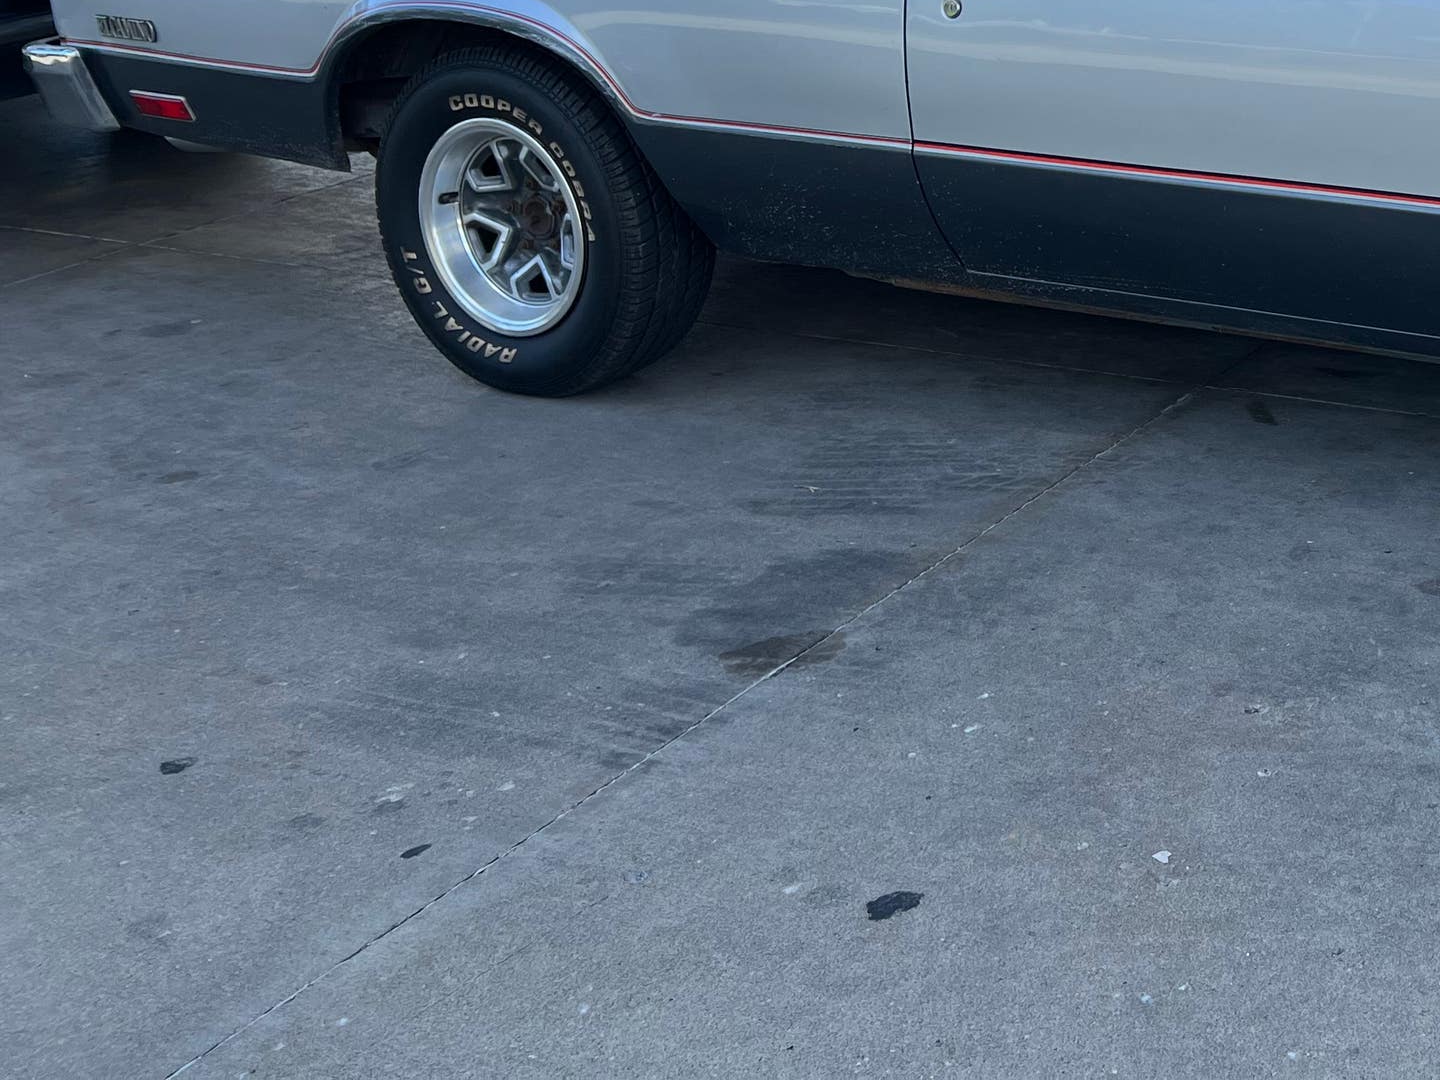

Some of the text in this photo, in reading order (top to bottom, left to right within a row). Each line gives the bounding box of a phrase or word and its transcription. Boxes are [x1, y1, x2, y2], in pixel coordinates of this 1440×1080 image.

[449, 93, 596, 242] COOPER COBRA
[431, 299, 518, 364] RADIAL
